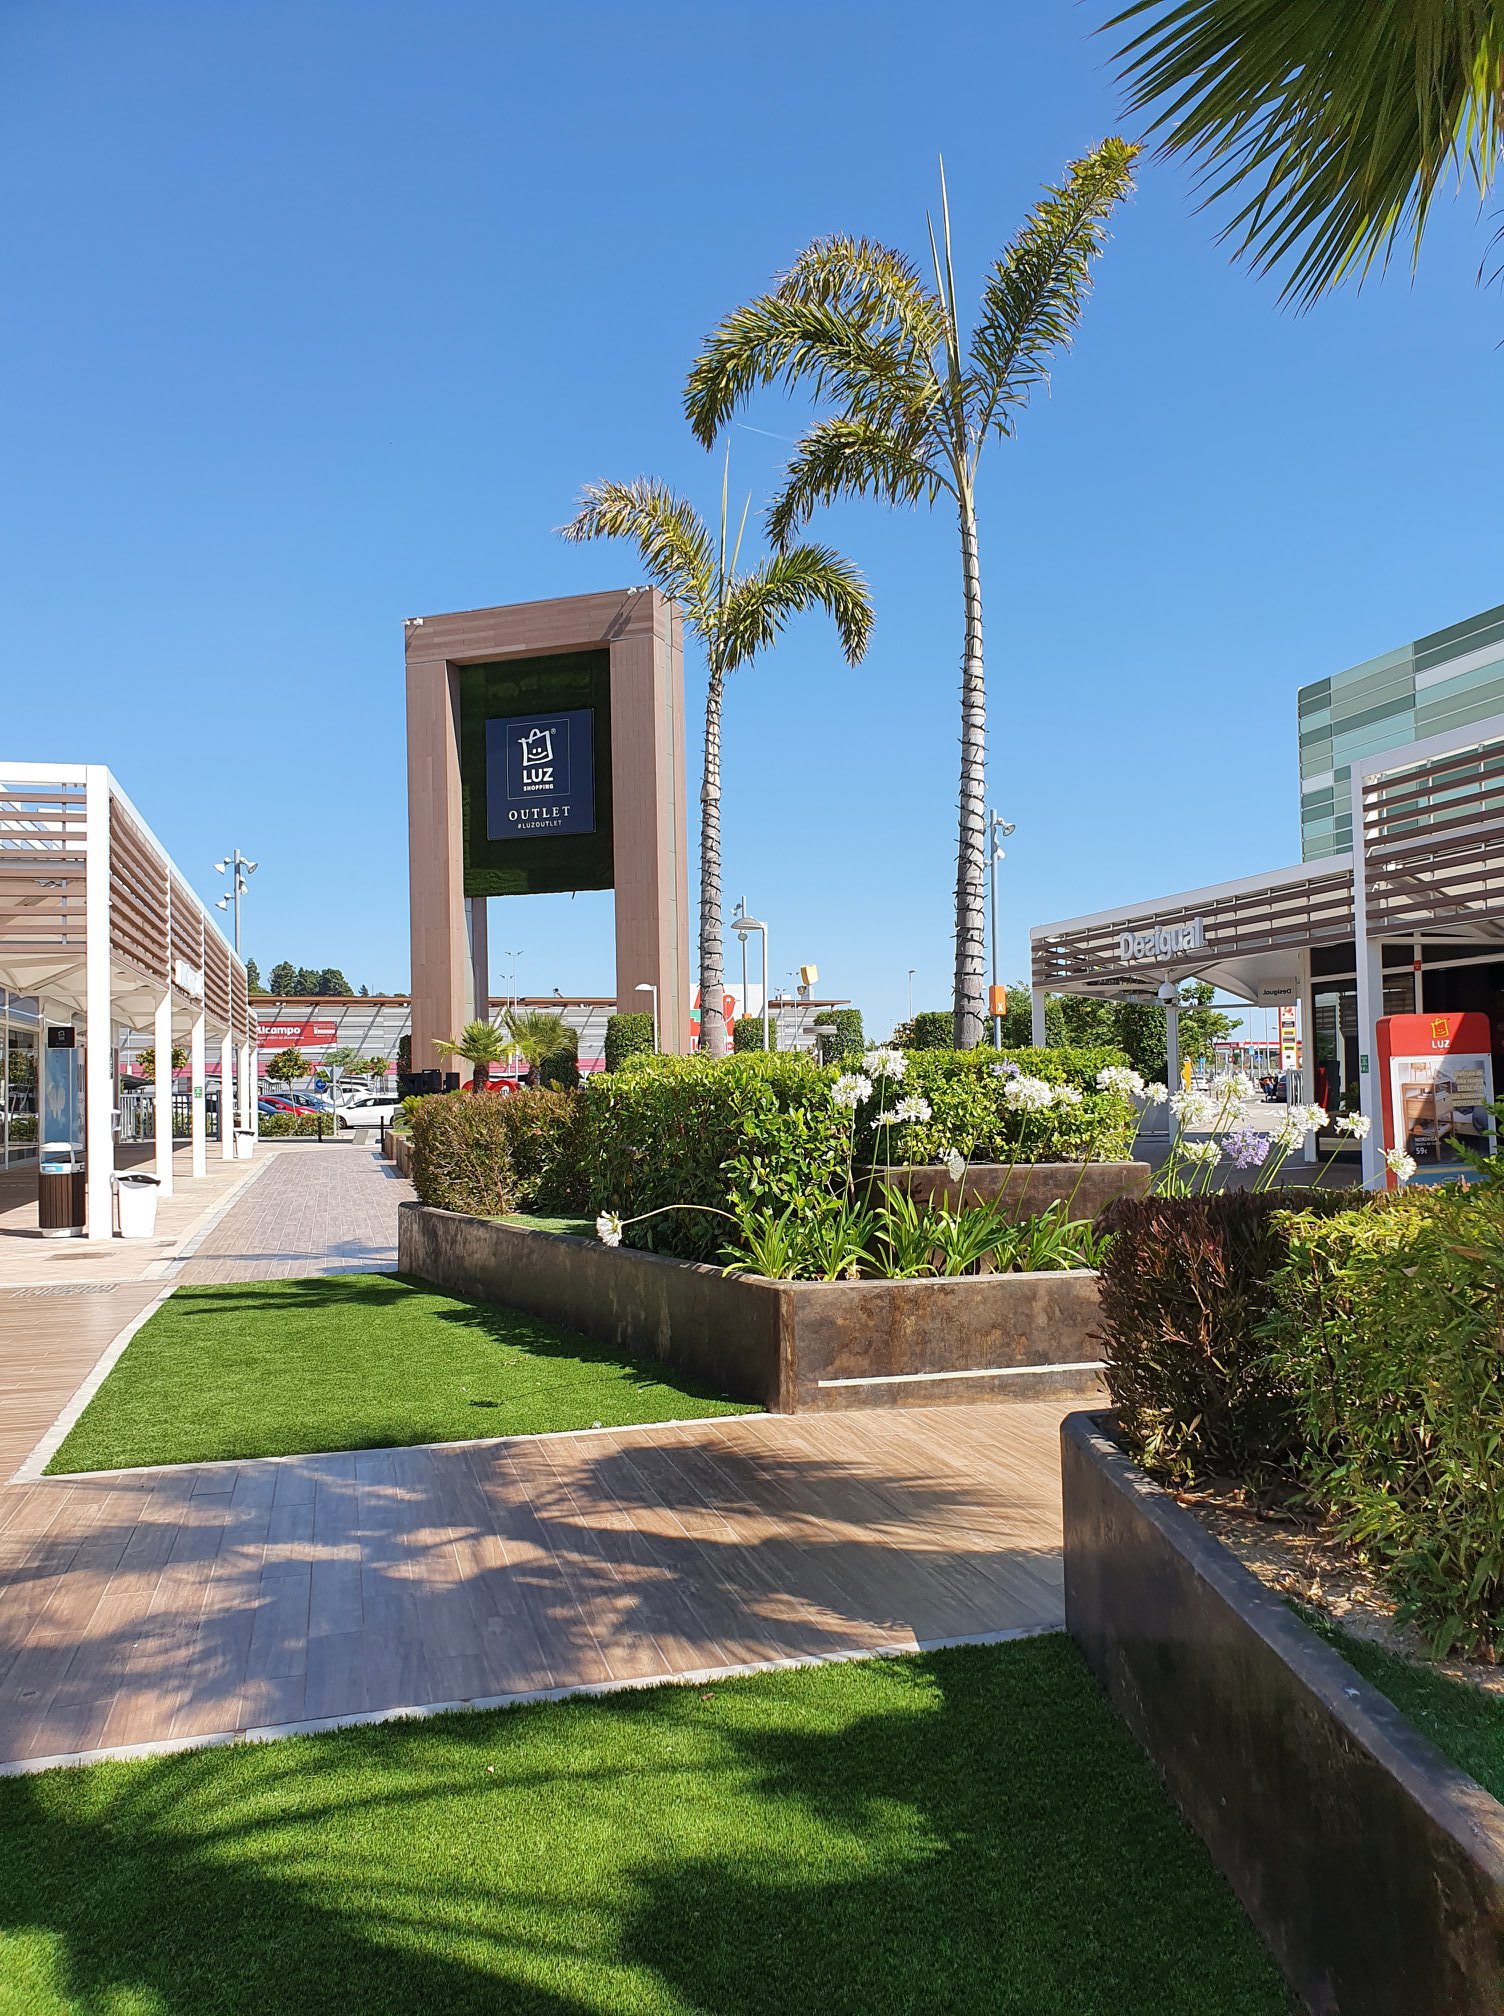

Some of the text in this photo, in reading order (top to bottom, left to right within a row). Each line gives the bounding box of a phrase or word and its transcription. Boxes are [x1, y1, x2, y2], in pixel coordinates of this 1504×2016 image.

[523, 768, 553, 783] LUZ
[523, 783, 554, 792] SHOPPING
[508, 805, 571, 821] OUTLET
[1431, 1039, 1451, 1049] LUZ
